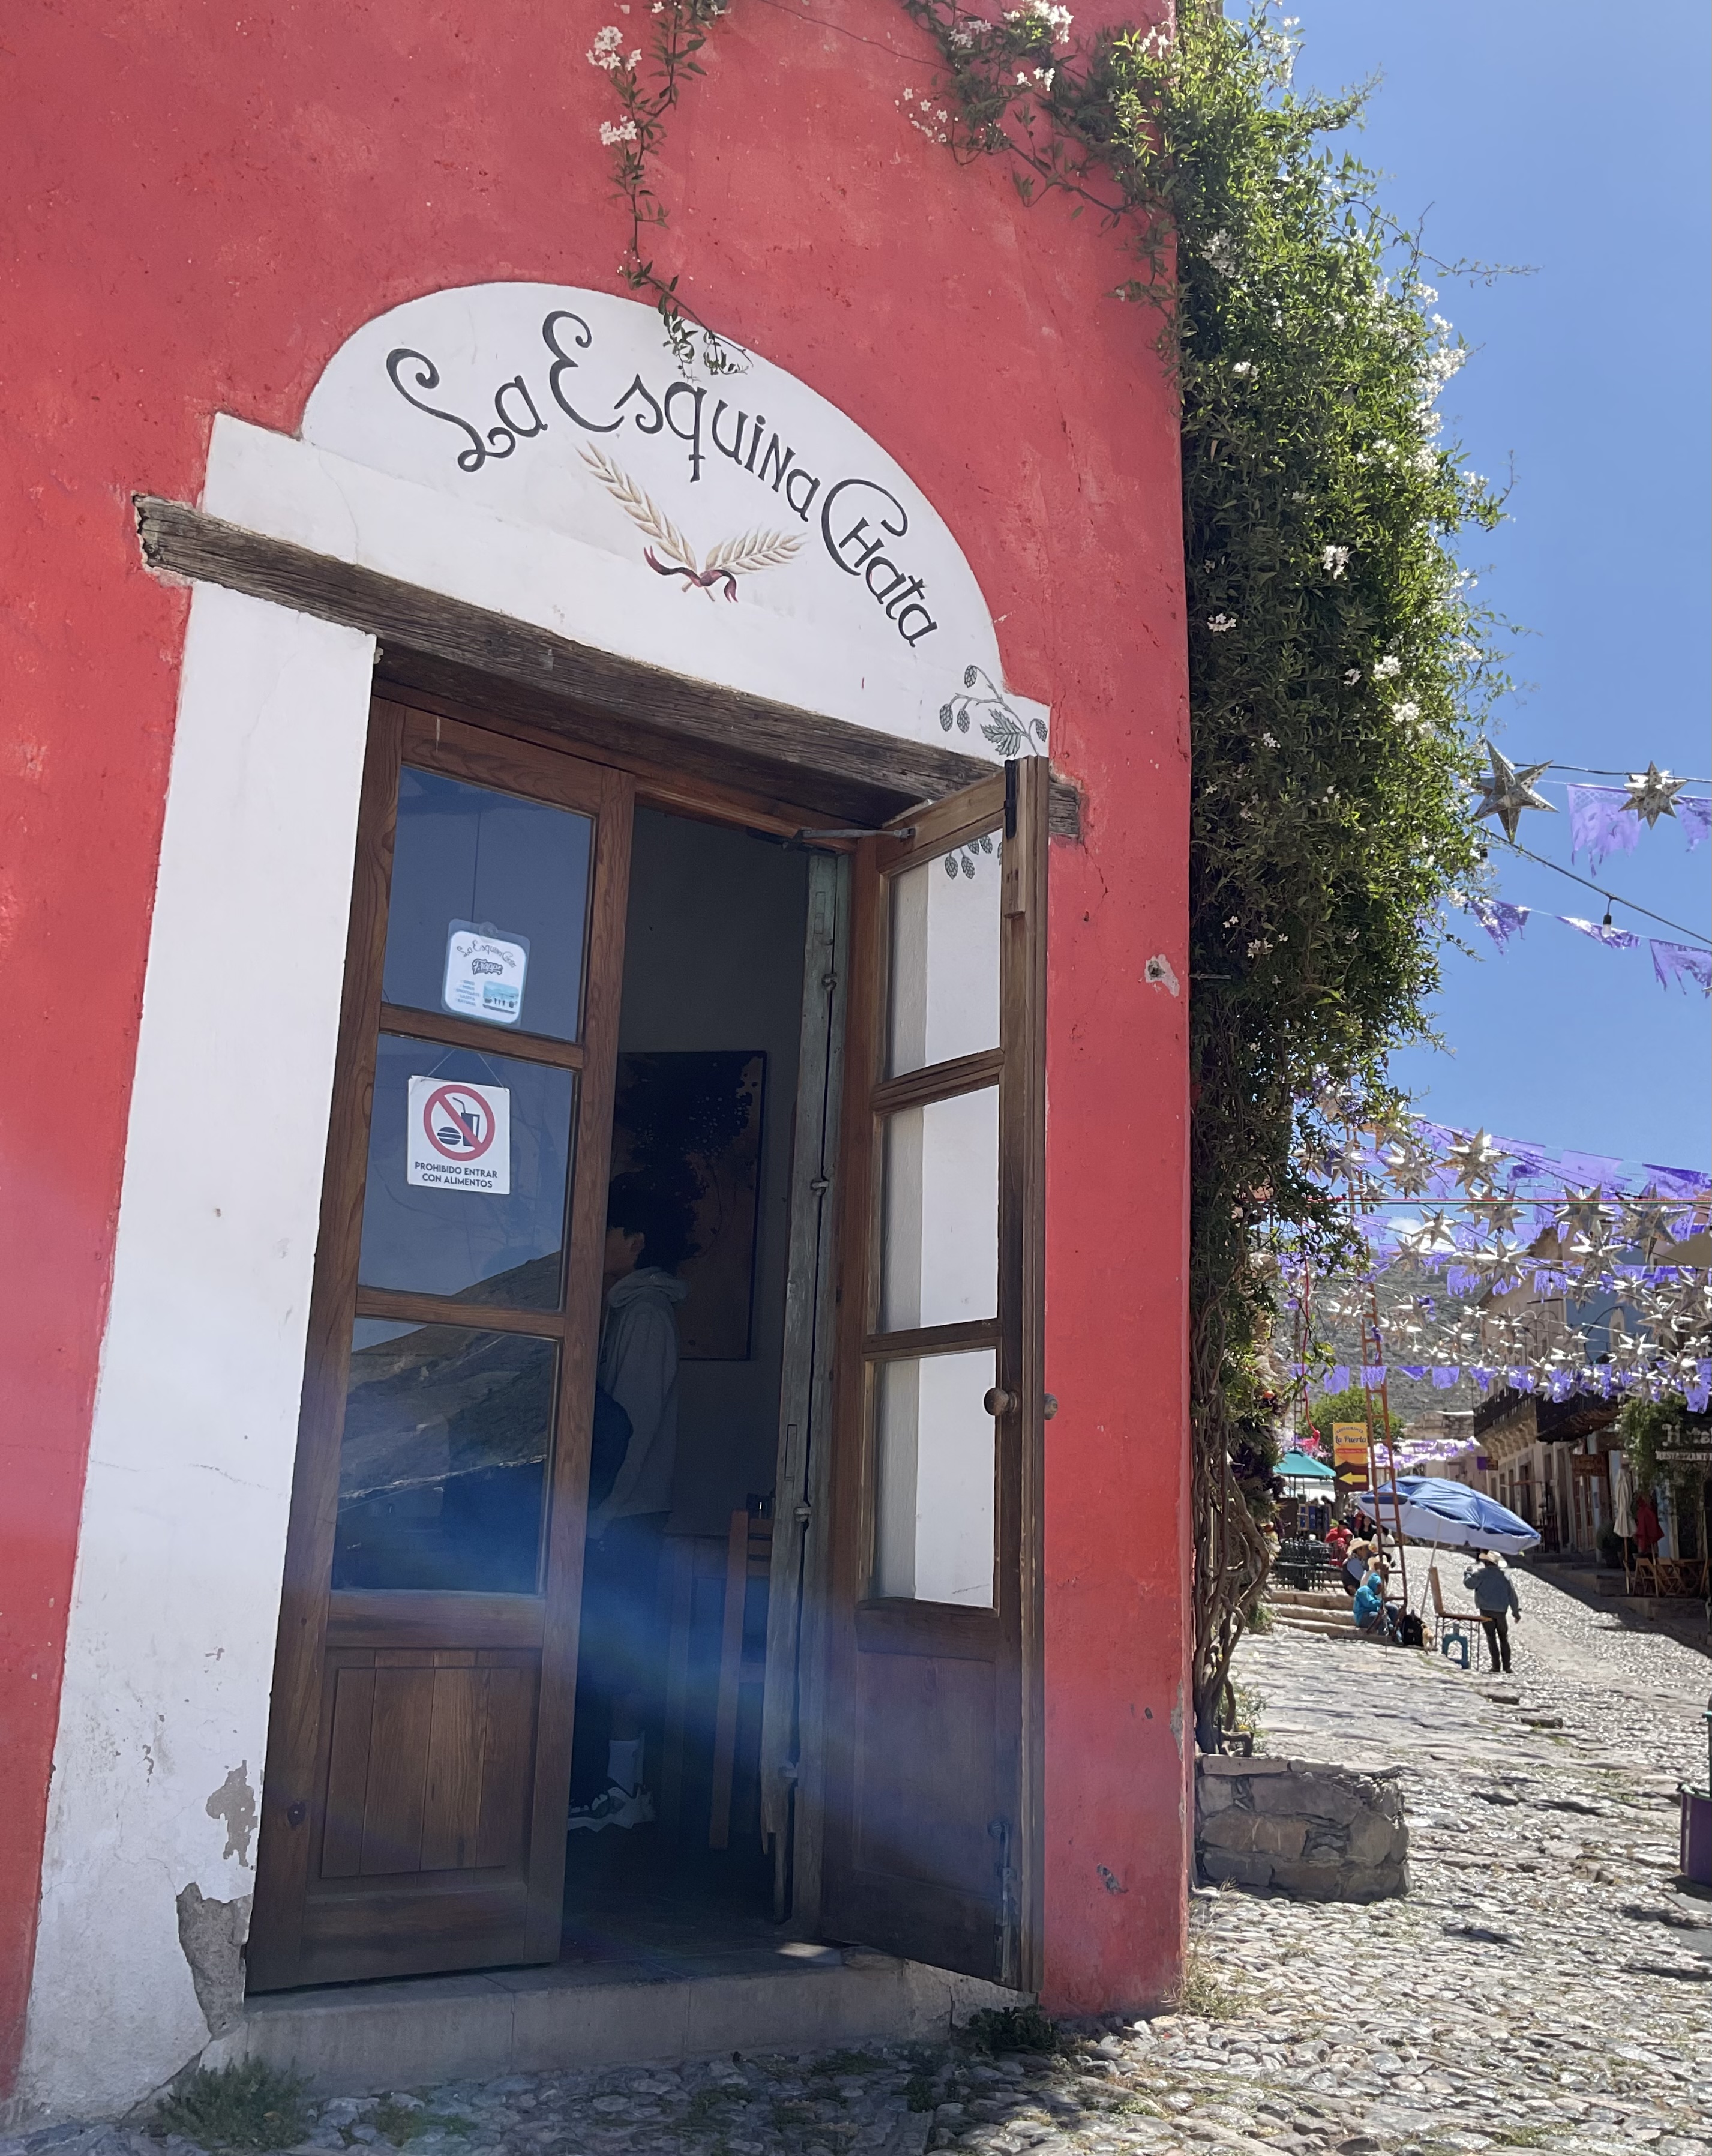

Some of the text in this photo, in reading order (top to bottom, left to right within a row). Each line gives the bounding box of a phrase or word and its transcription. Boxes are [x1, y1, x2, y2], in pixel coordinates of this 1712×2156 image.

[386, 348, 548, 472] La
[415, 1161, 497, 1178] PROHIBIDO ENTRAR
[422, 1173, 493, 1188] CON ALIMENTOS
[1335, 1435, 1342, 1445] La
